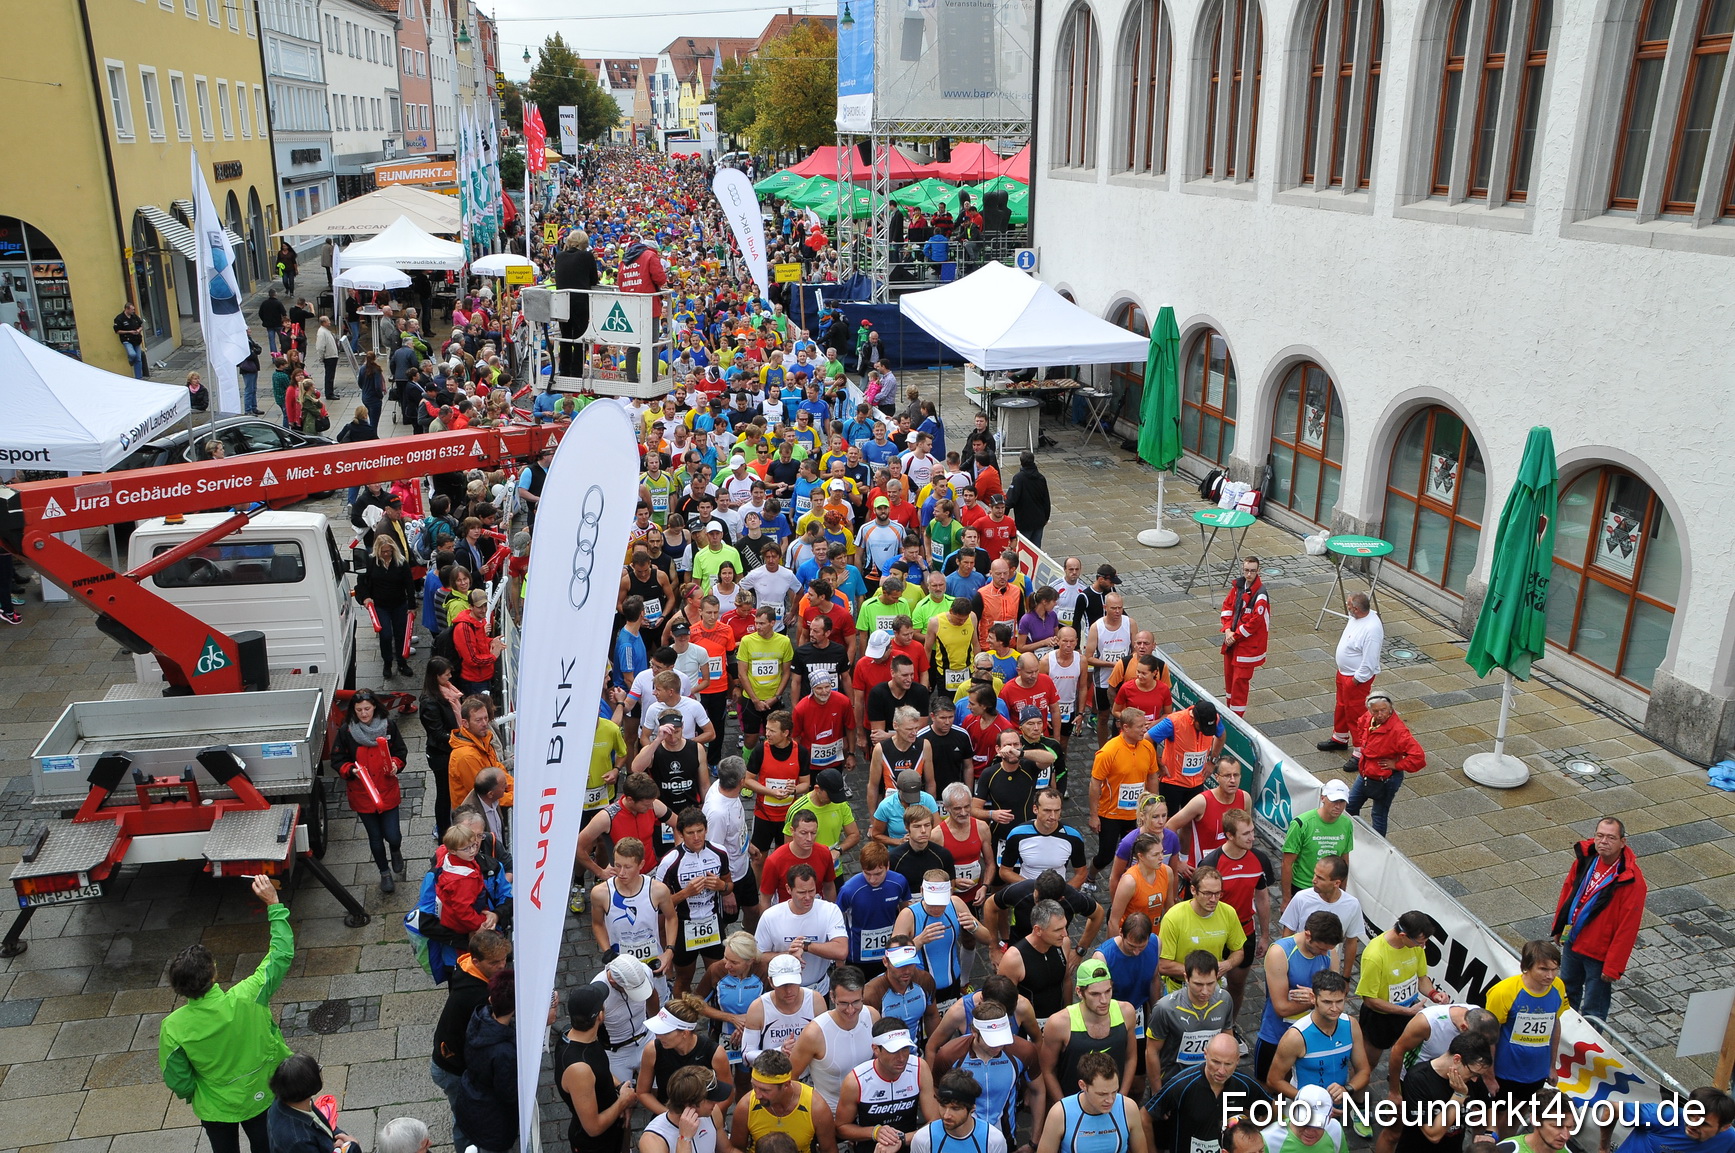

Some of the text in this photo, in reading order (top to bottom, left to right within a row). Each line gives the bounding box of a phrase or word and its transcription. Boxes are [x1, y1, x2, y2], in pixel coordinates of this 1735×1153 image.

[547, 230, 555, 239] A
[130, 403, 179, 445] BMW Laufsport
[286, 445, 465, 480] Miet- & Serviceline: 09181 6352
[70, 474, 253, 512] Jura Gebäude Service
[72, 571, 116, 588] RUTHMANN
[646, 603, 660, 615] 469
[757, 666, 774, 675] 632
[951, 673, 965, 683] 324
[529, 655, 577, 910] BKK Audi
[75, 885, 99, 899] 145
[692, 923, 713, 937] 166
[1393, 982, 1417, 1003] 2317
[1522, 1021, 1547, 1034] 245
[867, 1100, 916, 1114] Energizer
